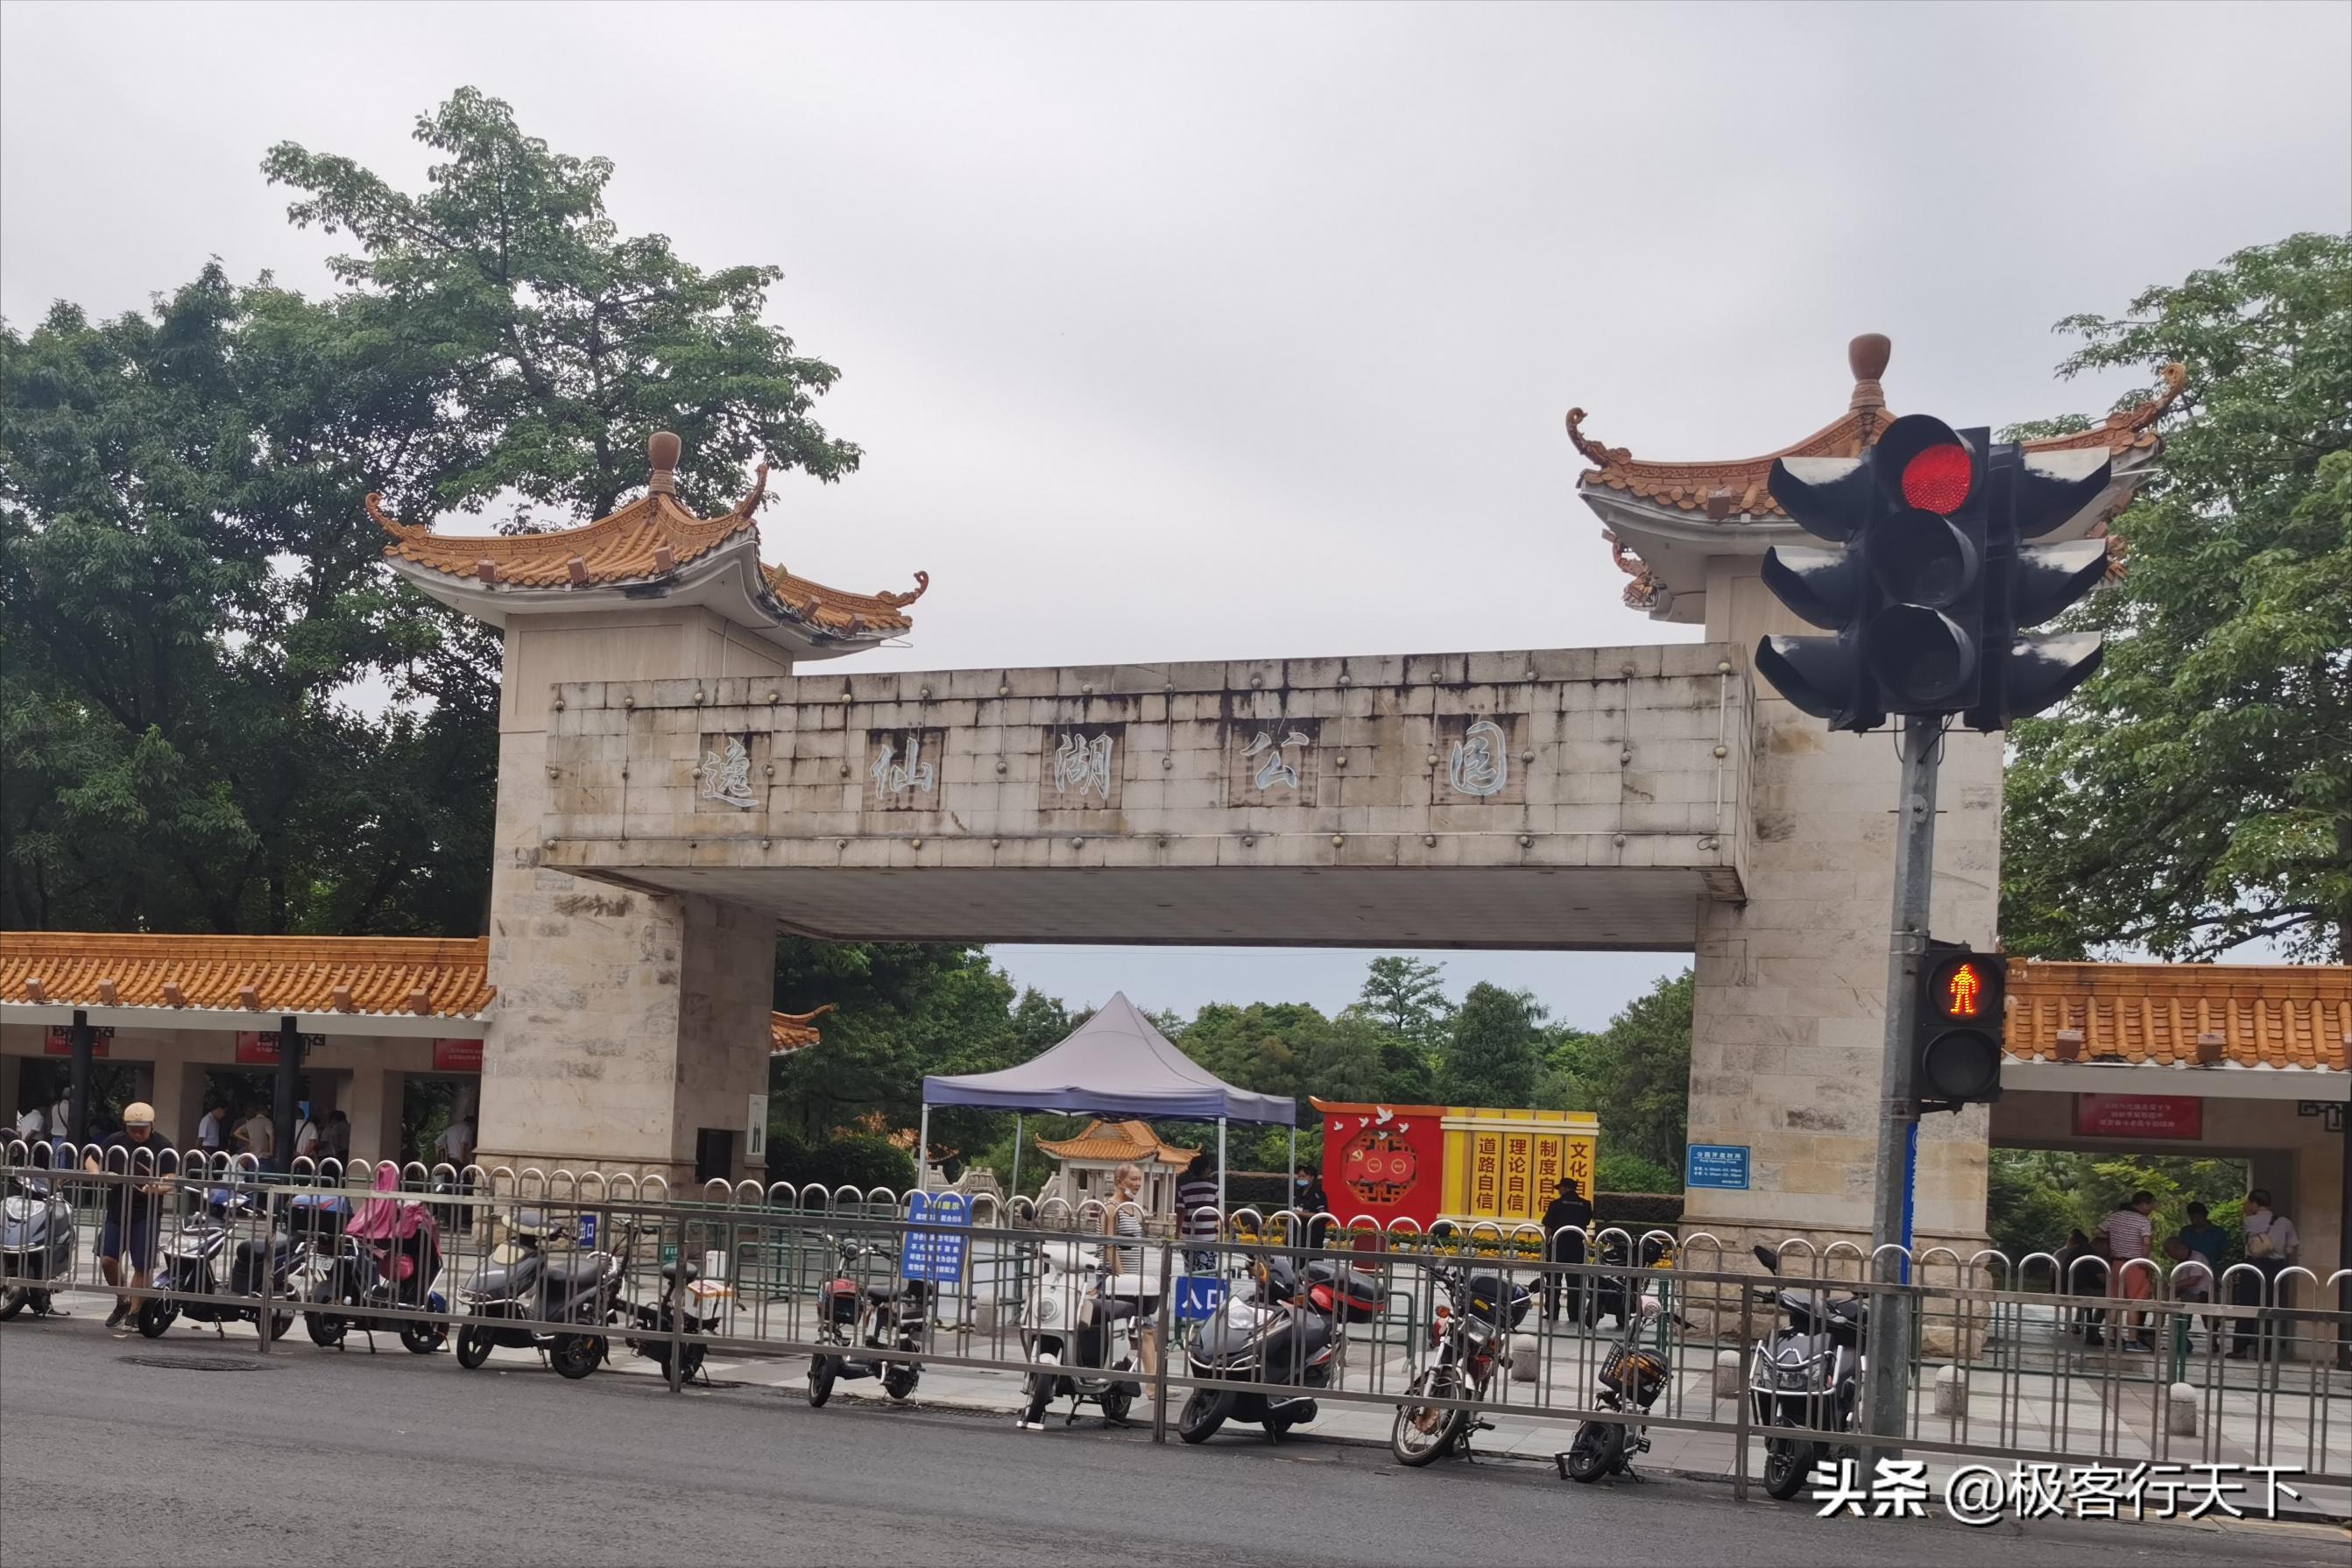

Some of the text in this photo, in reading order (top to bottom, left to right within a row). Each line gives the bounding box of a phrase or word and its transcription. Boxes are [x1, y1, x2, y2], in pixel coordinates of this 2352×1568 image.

[1475, 1137, 1497, 1211] 道路自信
[1506, 1139, 1528, 1212] 理论自信
[578, 1221, 595, 1240] 出口
[1182, 1287, 1225, 1310] 入口
